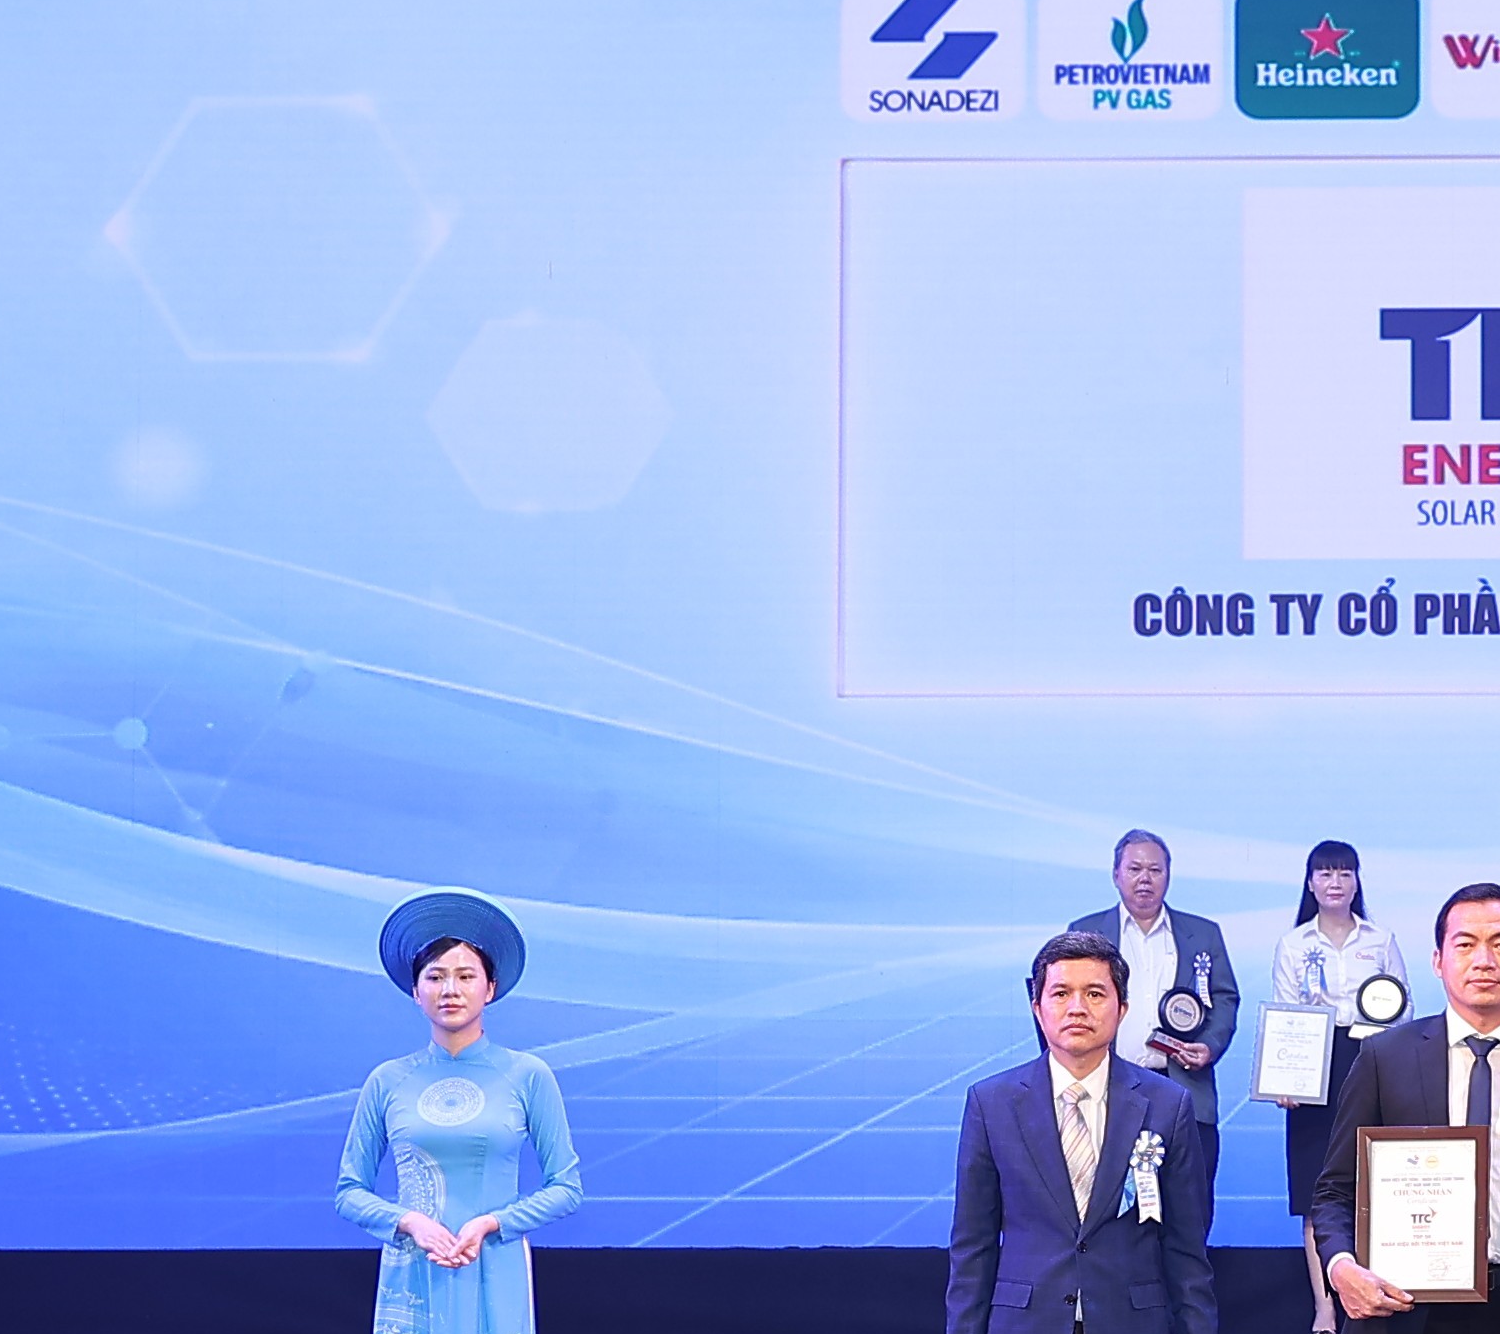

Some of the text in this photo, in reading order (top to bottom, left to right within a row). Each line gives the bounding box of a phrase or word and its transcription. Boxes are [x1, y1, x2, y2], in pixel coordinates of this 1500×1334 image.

[1055, 64, 1210, 85] PETROVIETNAM
[1256, 63, 1397, 87] Heineken
[869, 90, 998, 112] SONADEZI
[1093, 90, 1172, 110] PV GAS
[1417, 499, 1495, 525] SOLAR
[1133, 586, 1254, 637] CÔNG
[1270, 593, 1323, 635] TY
[1338, 577, 1398, 636] CỔ
[1411, 1213, 1432, 1224] TTC
